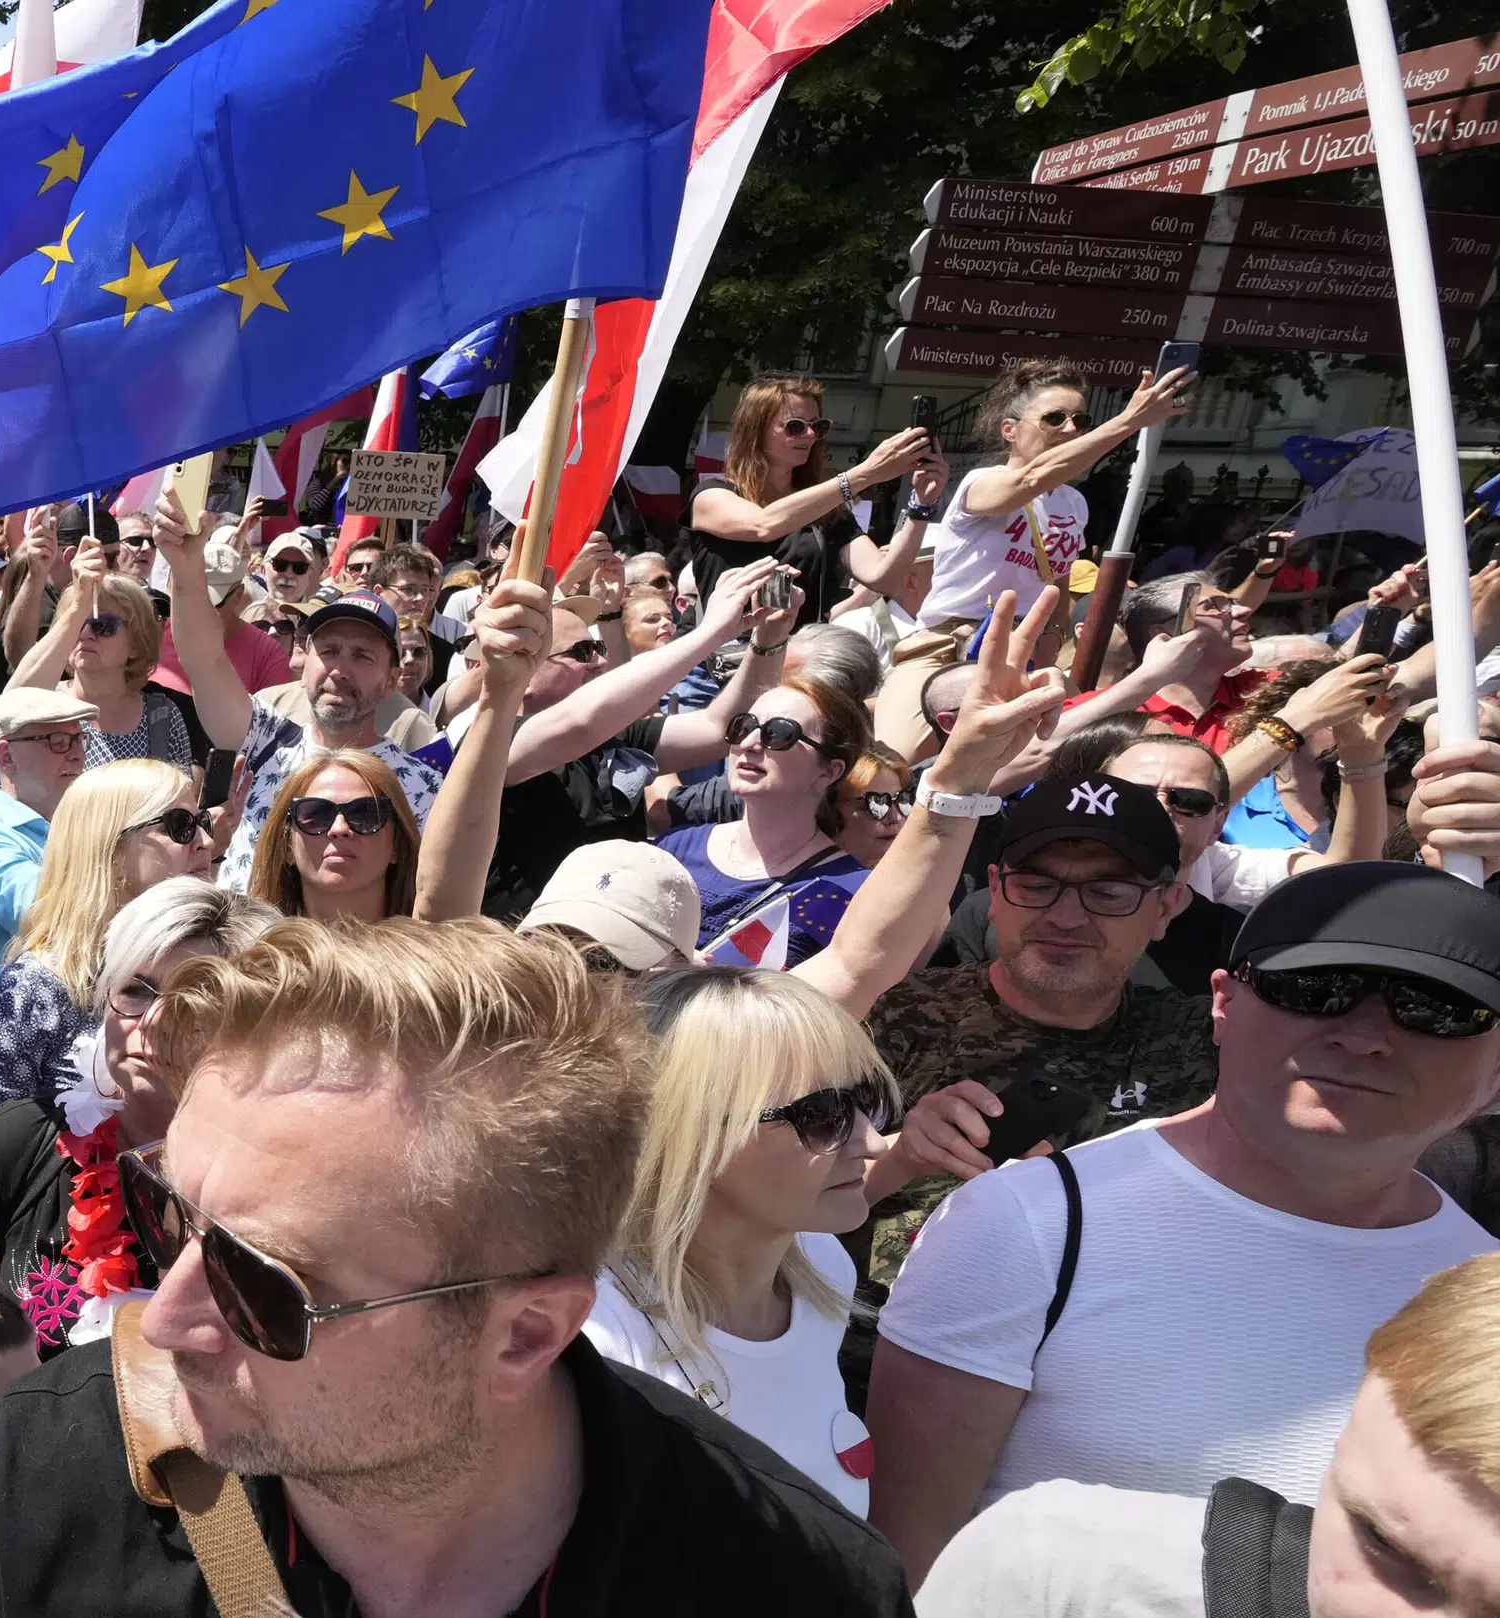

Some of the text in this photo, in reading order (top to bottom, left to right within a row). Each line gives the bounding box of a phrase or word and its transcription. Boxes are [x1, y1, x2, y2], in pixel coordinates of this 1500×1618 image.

[1258, 95, 1309, 123] Pomnik
[1045, 110, 1211, 166] Urząd do Spraw Cudzoziemców
[1241, 139, 1292, 177] Park
[1452, 119, 1477, 141] 50
[1477, 118, 1498, 136] m
[1039, 128, 1209, 184] Office for Foreigners 250 m
[1128, 167, 1159, 187] Serbii
[1167, 159, 1189, 177] 150
[1189, 157, 1202, 171] m
[953, 183, 1058, 205] Ministerstwo
[950, 202, 1195, 234] Edukacji i Nauki 600 m
[938, 232, 1183, 267] Muzeum Powstania Warszawskiego
[1251, 221, 1282, 240] Plac
[1290, 224, 1336, 243] Trzech
[1448, 237, 1475, 254] 700
[1475, 243, 1491, 256] m
[943, 254, 1020, 276] ekspozycja
[1131, 265, 1160, 282] 380
[1164, 270, 1180, 283] m
[1242, 254, 1322, 275] Ambasada
[1236, 273, 1304, 297] Embassy
[1306, 276, 1323, 294] of
[1460, 292, 1476, 304] m
[924, 295, 1168, 327] Plac Na Rozdrożu 250 m
[1222, 318, 1274, 337] Dolina
[1276, 321, 1369, 344] Szwajcarska
[909, 346, 995, 368] Ministerstwo
[1107, 359, 1135, 376] 100
[356, 454, 385, 467] KTO
[358, 482, 382, 494] TEN
[356, 495, 438, 516] DYKTATURZE
[1004, 514, 1028, 543] 4
[1066, 780, 1120, 817] NY
